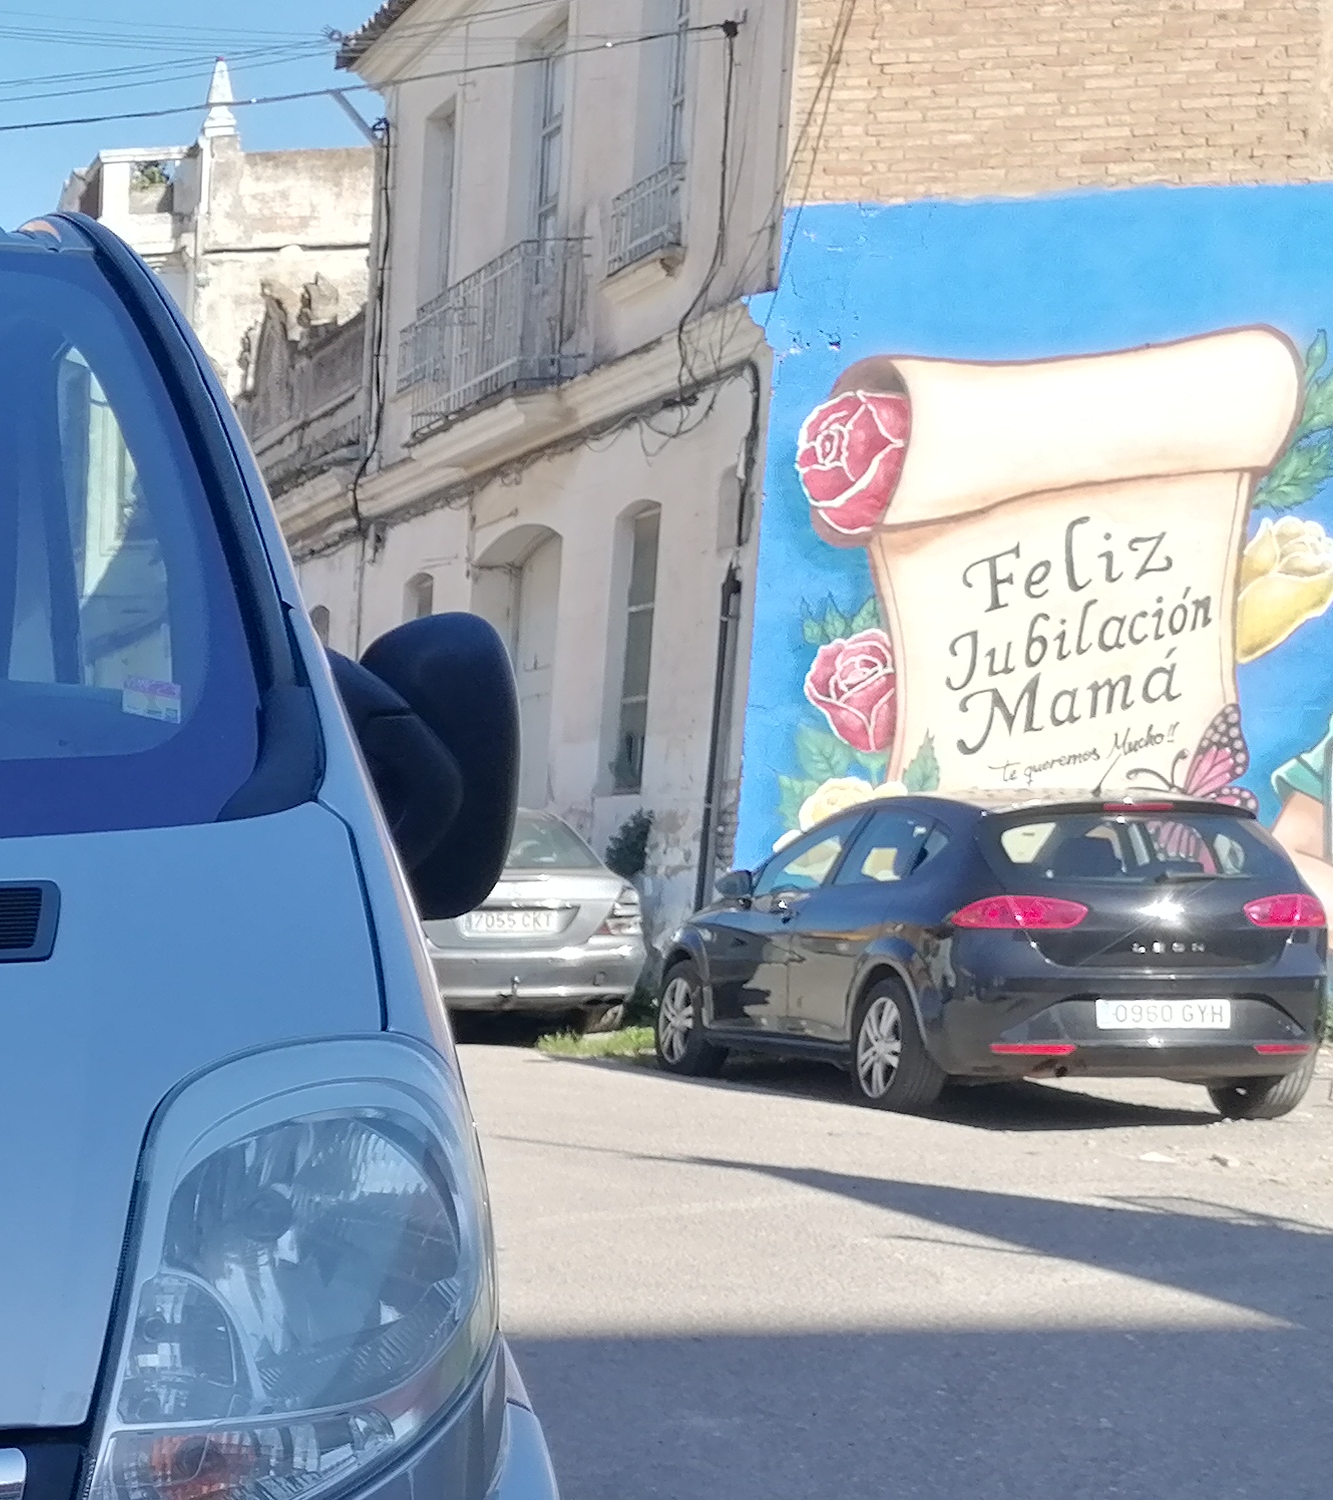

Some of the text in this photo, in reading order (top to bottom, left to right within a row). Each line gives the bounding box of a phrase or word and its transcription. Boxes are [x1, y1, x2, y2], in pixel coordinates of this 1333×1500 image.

[962, 516, 1173, 613] Feliz
[945, 587, 1213, 691] Jubilación
[956, 648, 1182, 756] Mamá
[1024, 748, 1101, 785] queremos
[1116, 1005, 1223, 1023] 0960 GYH
